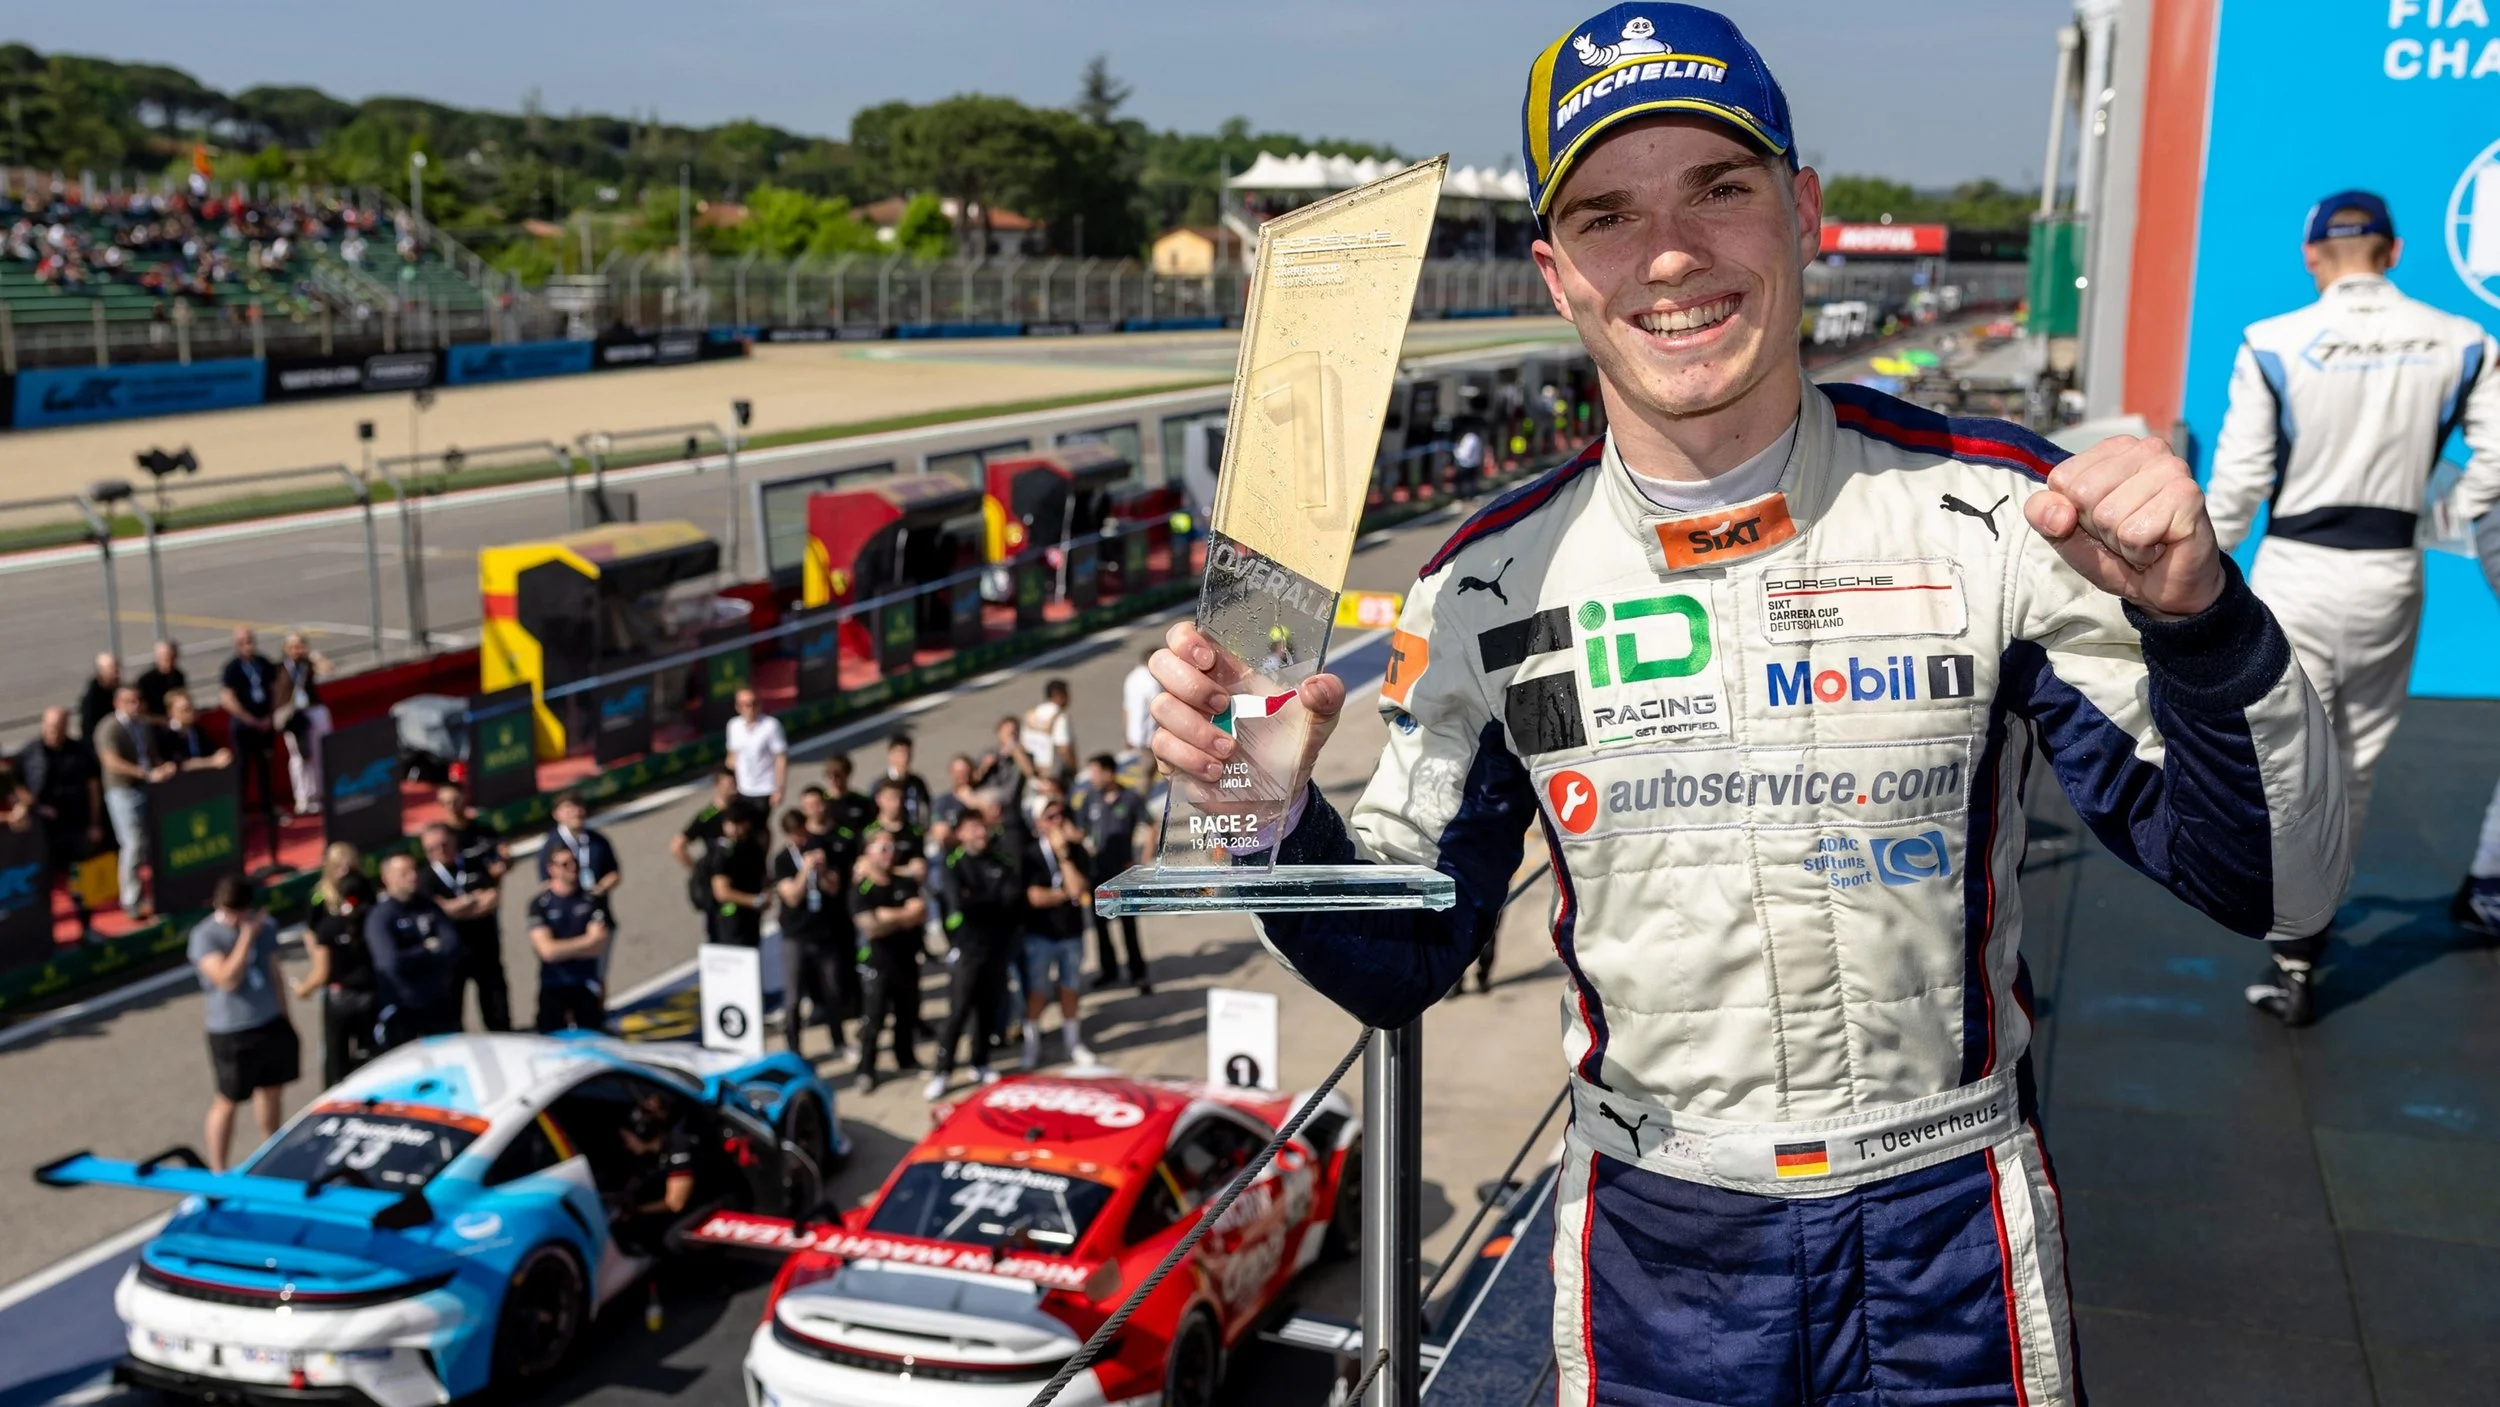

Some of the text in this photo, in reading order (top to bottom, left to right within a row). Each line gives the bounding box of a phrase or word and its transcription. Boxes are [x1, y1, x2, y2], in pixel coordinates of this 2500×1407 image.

[2387, 0, 2490, 29] FIA
[1557, 61, 1727, 132] MICHELIN
[1272, 231, 1391, 249] PORSCHE
[1274, 263, 1341, 278] CARRERA CUP
[1274, 276, 1345, 287] DEUTSCHLAND
[1212, 543, 1331, 623] OVERALL
[1766, 576, 1894, 591] PORSCHE
[1768, 600, 1791, 610] SIXT
[1769, 607, 1839, 621] CARRERA CUP
[1770, 617, 1844, 632] DEUTSCHLAND
[1766, 656, 1960, 707] Mobil 1
[1593, 694, 1717, 728] RACING
[1635, 726, 1657, 737] GET
[1223, 762, 1249, 775] WEC
[1219, 778, 1252, 789] IMOLA
[1610, 762, 1960, 813] autoservice.com
[1189, 813, 1258, 834] RACE 2
[1190, 836, 1260, 850] 19 APR 2026
[1818, 837, 1859, 853] ADAC
[1803, 855, 1866, 872] Stiftung
[1829, 870, 1873, 890] Sport
[1231, 1058, 1251, 1087] 1
[1854, 1102, 1999, 1161] T. Oeverhaus
[325, 1133, 394, 1170] 13
